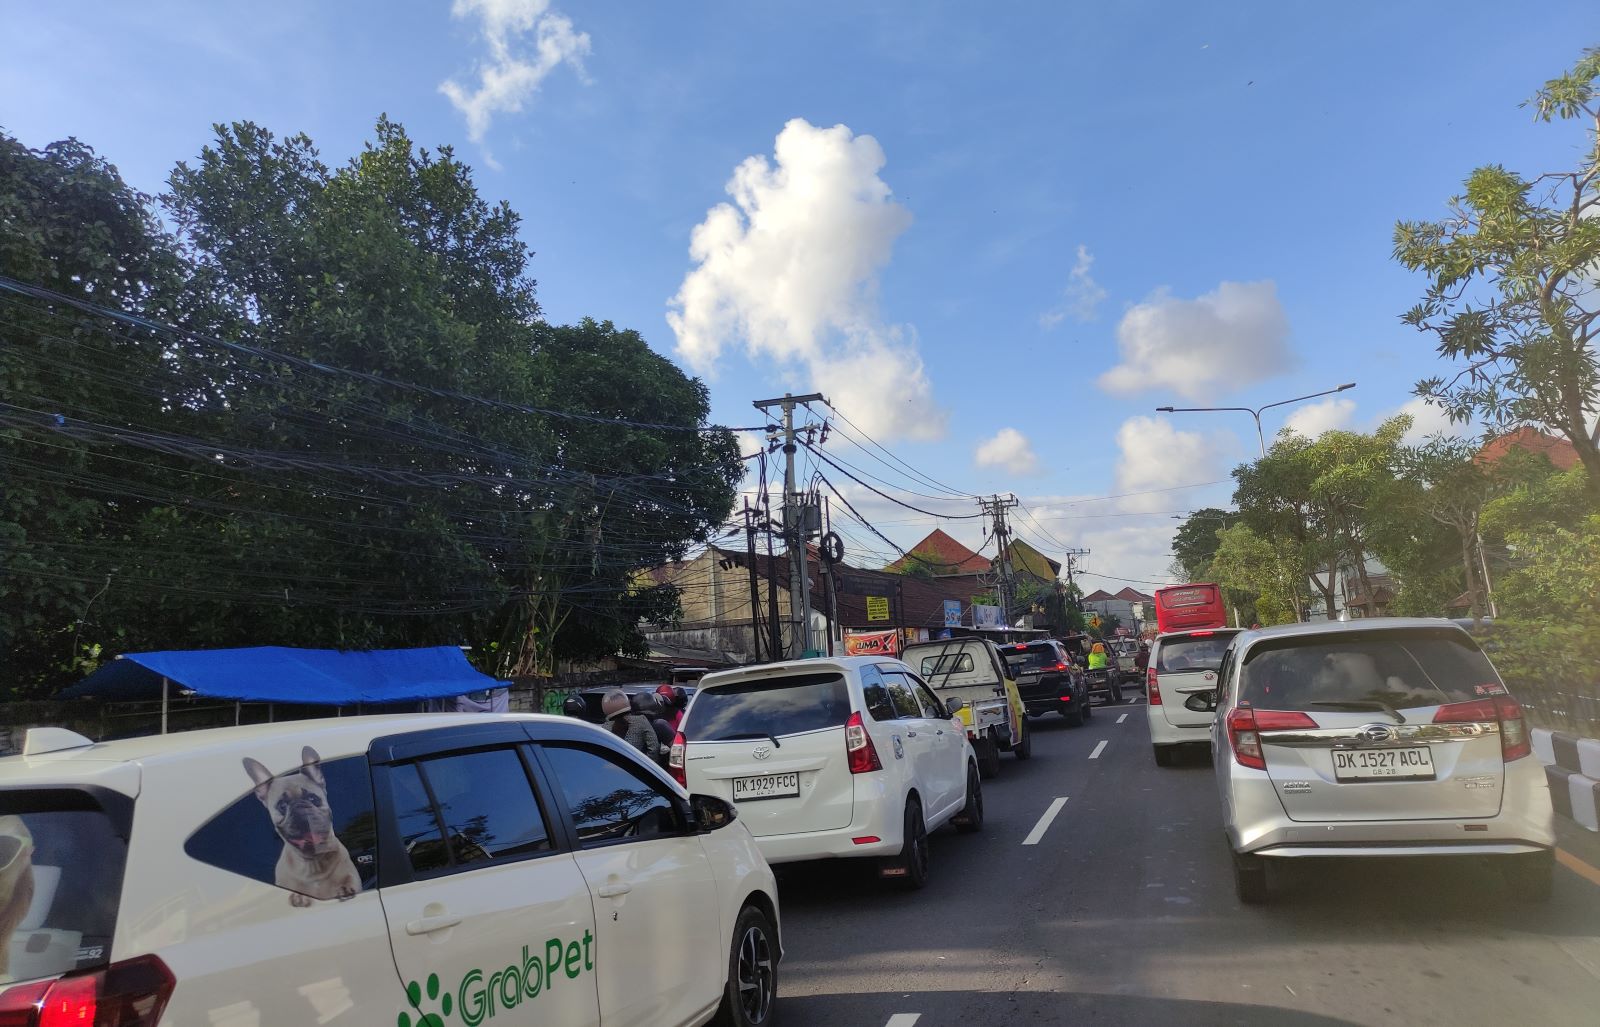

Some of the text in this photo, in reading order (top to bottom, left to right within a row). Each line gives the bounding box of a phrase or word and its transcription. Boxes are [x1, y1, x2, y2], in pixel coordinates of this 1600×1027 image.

[1337, 750, 1429, 768] DK 1527 ACL
[736, 775, 796, 792] DK 1929 FCC
[458, 929, 593, 1027] GrabPet
